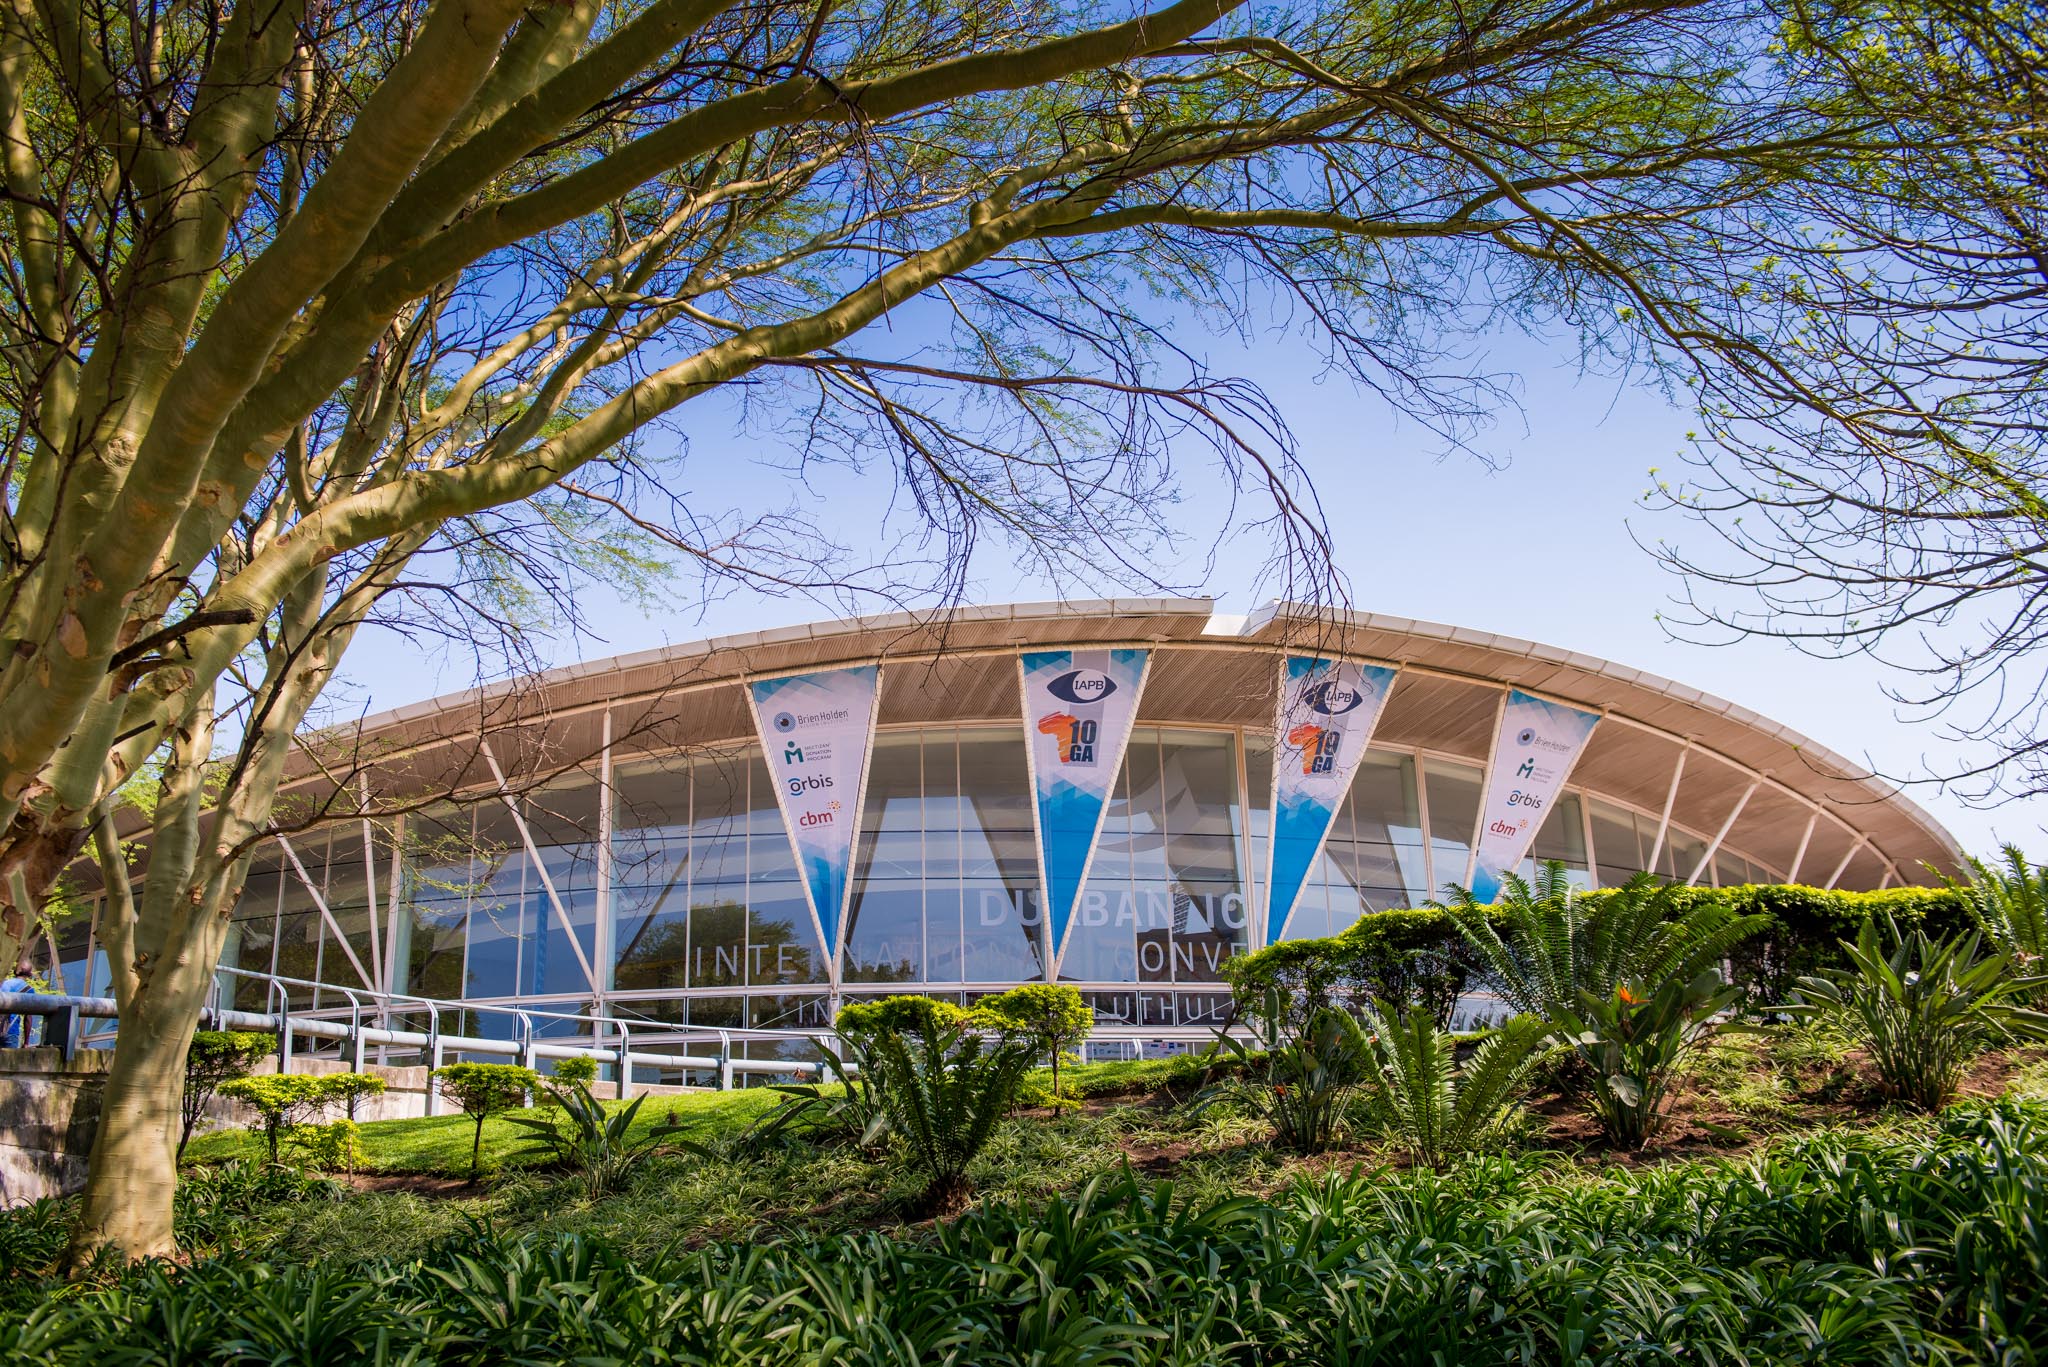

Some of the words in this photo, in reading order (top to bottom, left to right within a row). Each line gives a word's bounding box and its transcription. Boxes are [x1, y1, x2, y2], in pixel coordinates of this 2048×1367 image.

[1074, 680, 1104, 690] IAPB
[1326, 691, 1353, 703] IAPB
[797, 714, 820, 725] Brien
[819, 708, 849, 721] Holden
[1070, 719, 1097, 744] 10
[1070, 745, 1093, 763] GA
[1312, 755, 1333, 774] GA
[790, 773, 833, 793] orbis
[1509, 793, 1542, 809] orbis
[799, 811, 833, 826] cbm
[1490, 820, 1516, 836] cbm
[979, 888, 1176, 928] DUBAN
